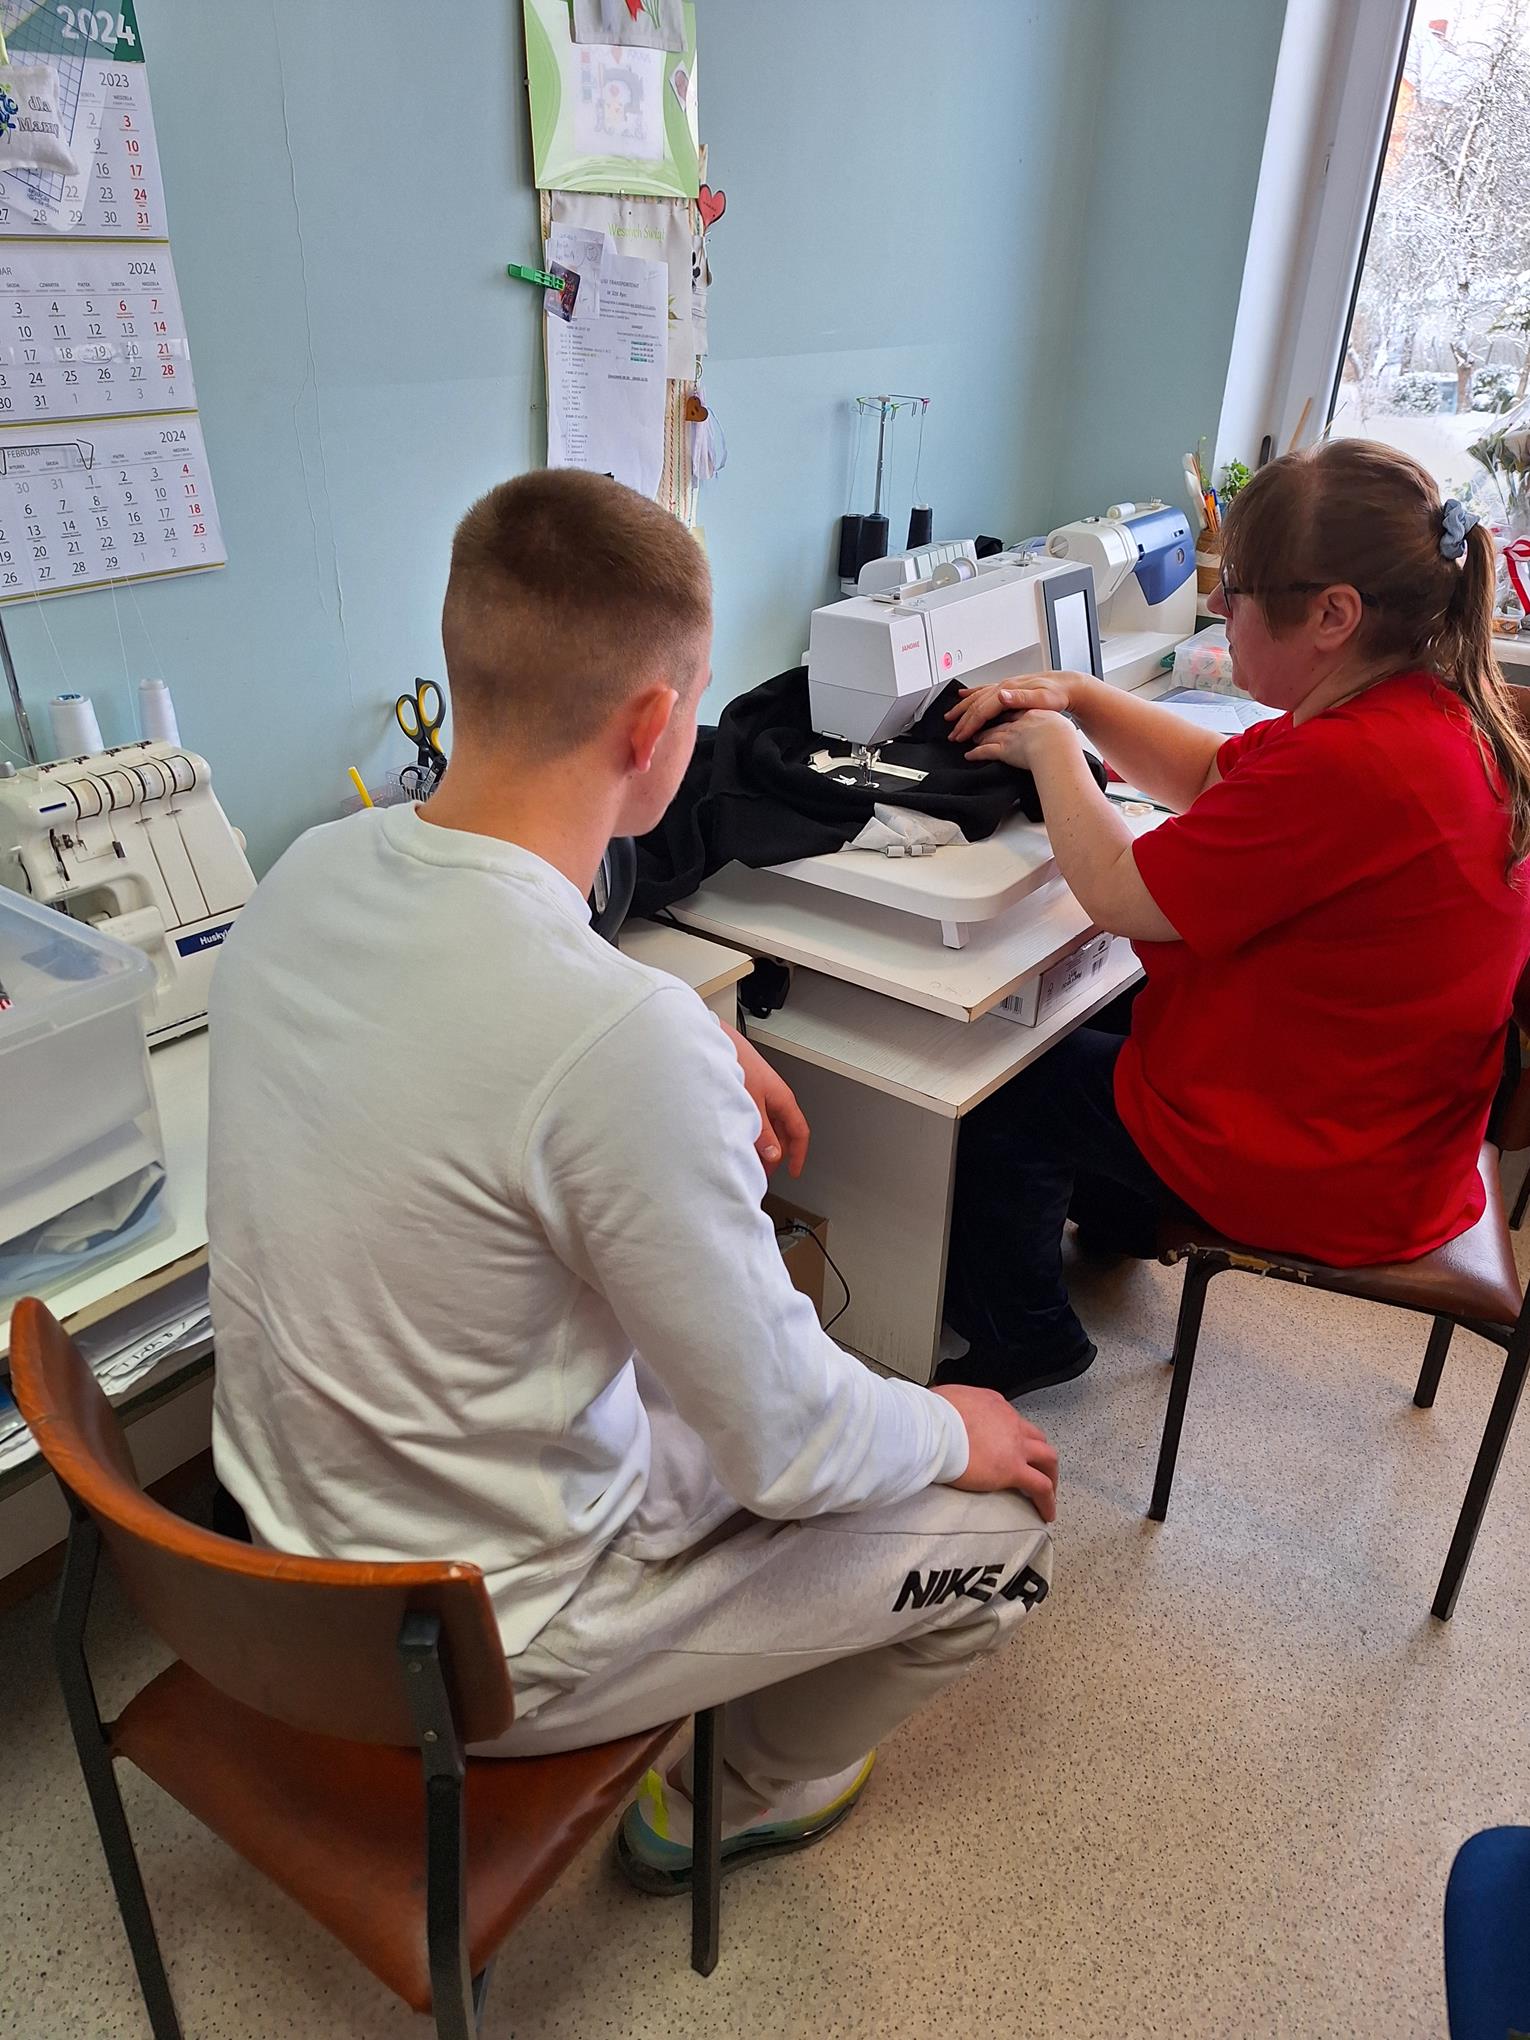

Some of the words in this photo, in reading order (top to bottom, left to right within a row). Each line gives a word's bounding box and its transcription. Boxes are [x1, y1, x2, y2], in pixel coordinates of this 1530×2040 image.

[57, 5, 135, 46] 2024
[99, 72, 129, 88] 2023
[28, 96, 52, 112] dla
[17, 117, 59, 138] Mamy
[89, 113, 96, 125] 2
[124, 115, 131, 127] 3
[94, 138, 101, 150] 9
[126, 140, 139, 153] 10
[96, 162, 110, 175] 16
[130, 164, 142, 176] 17
[65, 186, 78, 197] 22
[101, 187, 113, 199] 23
[134, 189, 147, 200] 24
[33, 210, 47, 221] 28
[70, 210, 83, 222] 29
[104, 211, 117, 223] 30
[137, 213, 149, 224] 31
[128, 262, 156, 275] 2024
[15, 302, 23, 314] 3
[52, 302, 59, 313] 4
[86, 301, 93, 312] 5
[120, 300, 127, 311] 6
[151, 299, 158, 310] 7
[18, 326, 32, 338] 10
[54, 325, 66, 337] 11
[89, 323, 102, 335] 12
[122, 322, 135, 334] 13
[154, 321, 166, 332] 14
[24, 349, 36, 361] 17
[60, 348, 73, 359] 18
[94, 346, 106, 358] 19
[127, 344, 139, 356] 20
[157, 343, 169, 354] 21
[29, 372, 43, 384] 24
[64, 370, 78, 382] 25
[97, 368, 111, 380] 26
[130, 366, 142, 378] 27
[162, 364, 174, 376] 28
[33, 395, 46, 407] 31
[73, 392, 78, 404] 1
[105, 390, 112, 401] 2
[137, 387, 144, 400] 3
[168, 386, 175, 396] 4
[160, 430, 186, 443] 2024
[7, 448, 41, 459] FEBRUAR
[15, 482, 30, 494] 30
[50, 478, 64, 490] 31
[88, 475, 94, 485] 1
[120, 471, 128, 481] 2
[152, 467, 159, 478] 3
[182, 464, 189, 474] 4
[24, 504, 33, 515] 6
[60, 499, 66, 510] 7
[93, 495, 101, 506] 8
[125, 491, 133, 502] 9
[155, 487, 167, 498] 10
[184, 484, 195, 494] 11
[28, 525, 41, 536] 13
[62, 520, 76, 531] 14
[96, 516, 109, 527] 15
[128, 512, 141, 523] 16
[160, 508, 170, 518] 17
[189, 504, 201, 514] 18
[33, 546, 47, 558] 20
[67, 541, 80, 552] 21
[101, 536, 114, 548] 22
[132, 531, 145, 543] 23
[163, 528, 176, 538] 24
[193, 523, 205, 534] 25
[3, 572, 18, 584] 26
[38, 567, 51, 578] 27
[72, 561, 86, 573] 28
[105, 556, 118, 568] 29
[141, 552, 145, 562] 1
[171, 547, 177, 558] 2
[200, 542, 207, 553] 3
[901, 641, 920, 652] JANOME
[892, 1563, 1005, 1612] NIKE
